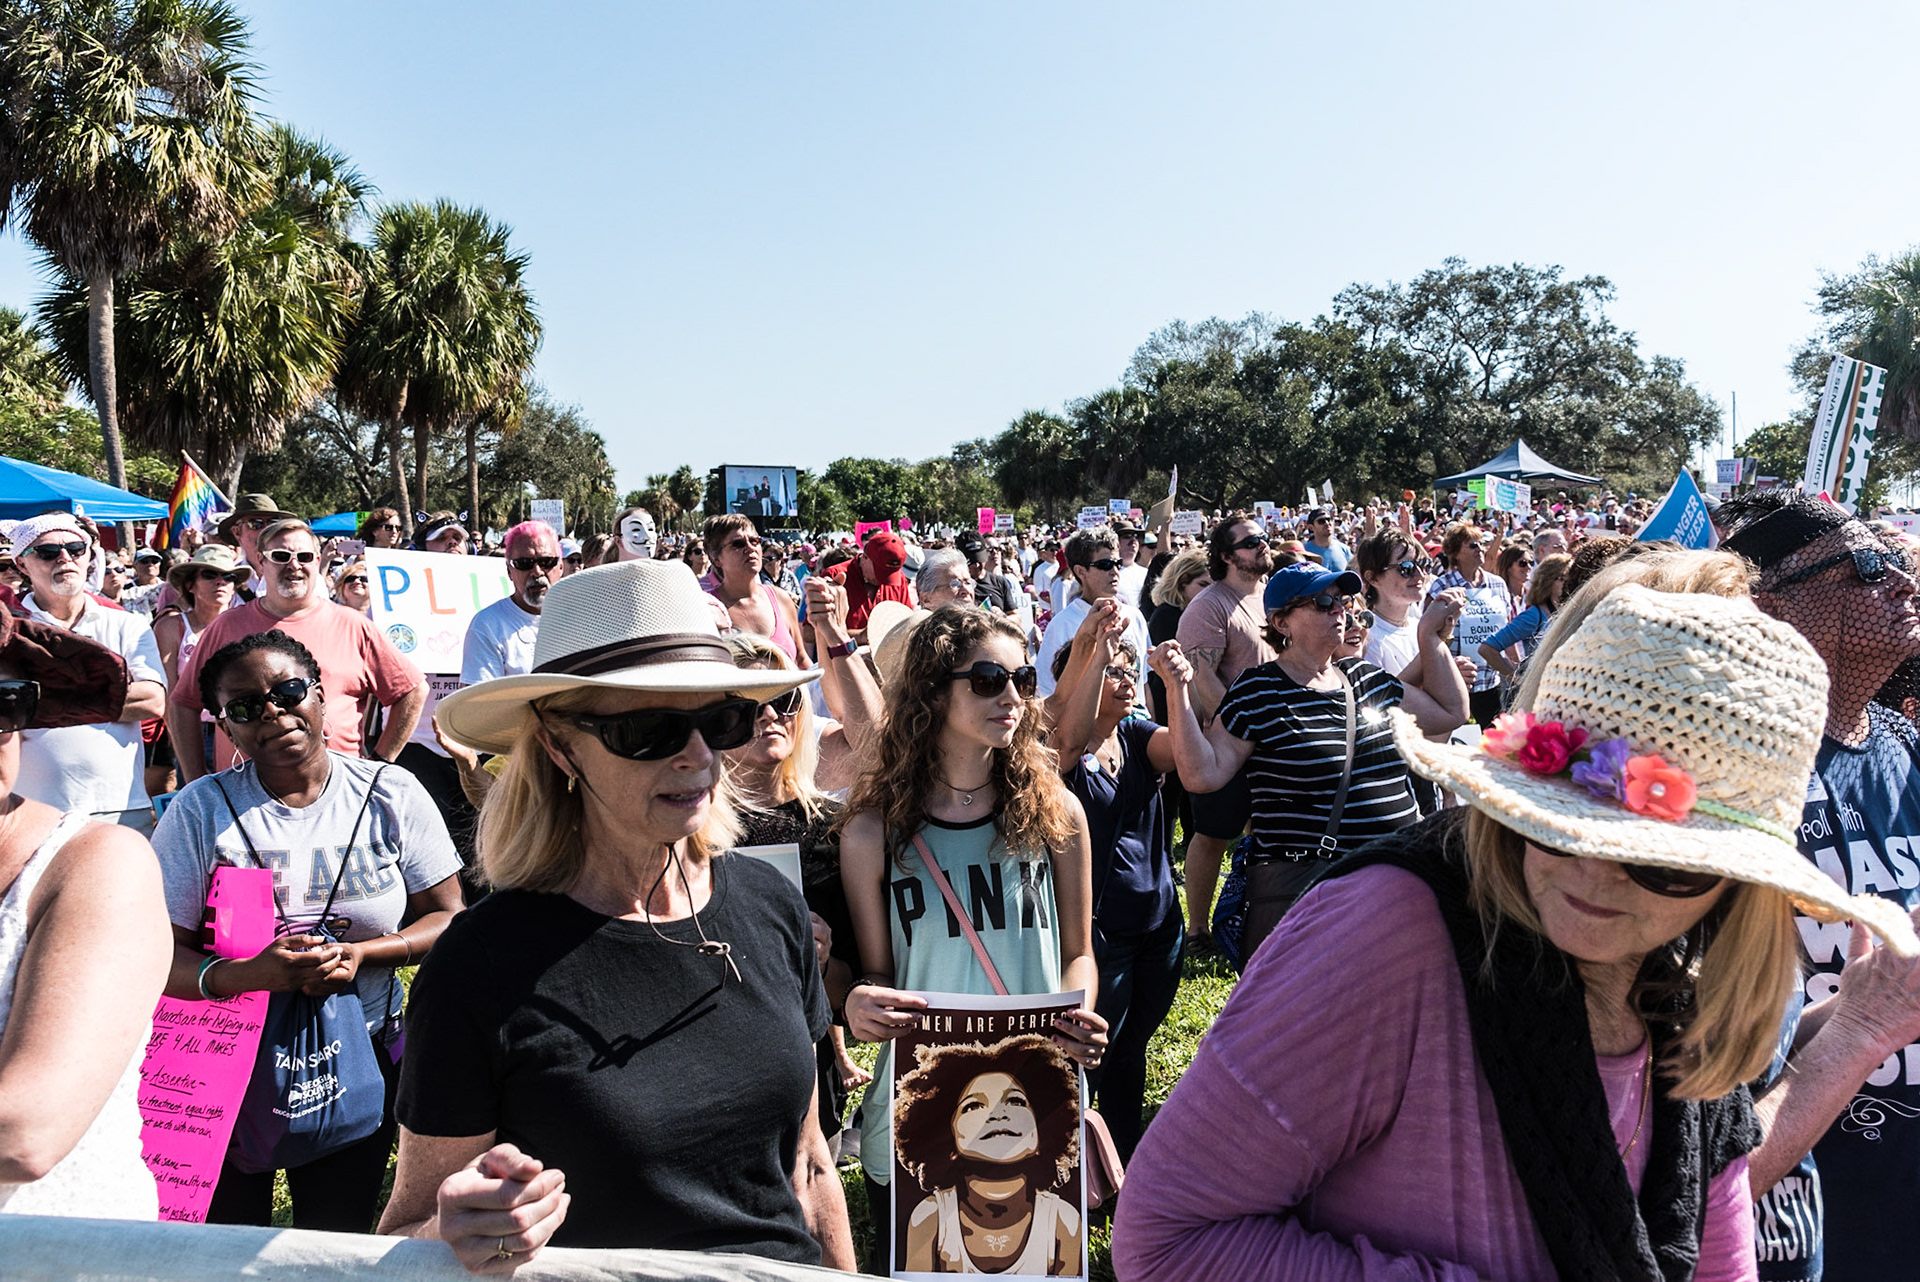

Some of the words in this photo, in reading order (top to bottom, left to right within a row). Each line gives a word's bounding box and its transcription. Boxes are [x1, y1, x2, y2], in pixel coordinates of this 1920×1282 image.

[1826, 378, 1841, 427] SENATE
[1812, 429, 1829, 487] DISTRICT
[432, 682, 443, 690] ST.
[1800, 808, 1833, 843] roll
[1836, 803, 1865, 832] with
[303, 845, 399, 905] ARE
[891, 862, 1049, 947] PINK
[197, 1009, 213, 1026] for
[212, 1012, 244, 1040] helping
[914, 1015, 953, 1033] MEN
[966, 1016, 995, 1033] ARE
[180, 1036, 201, 1054] ALL
[204, 1039, 237, 1056] MAKES
